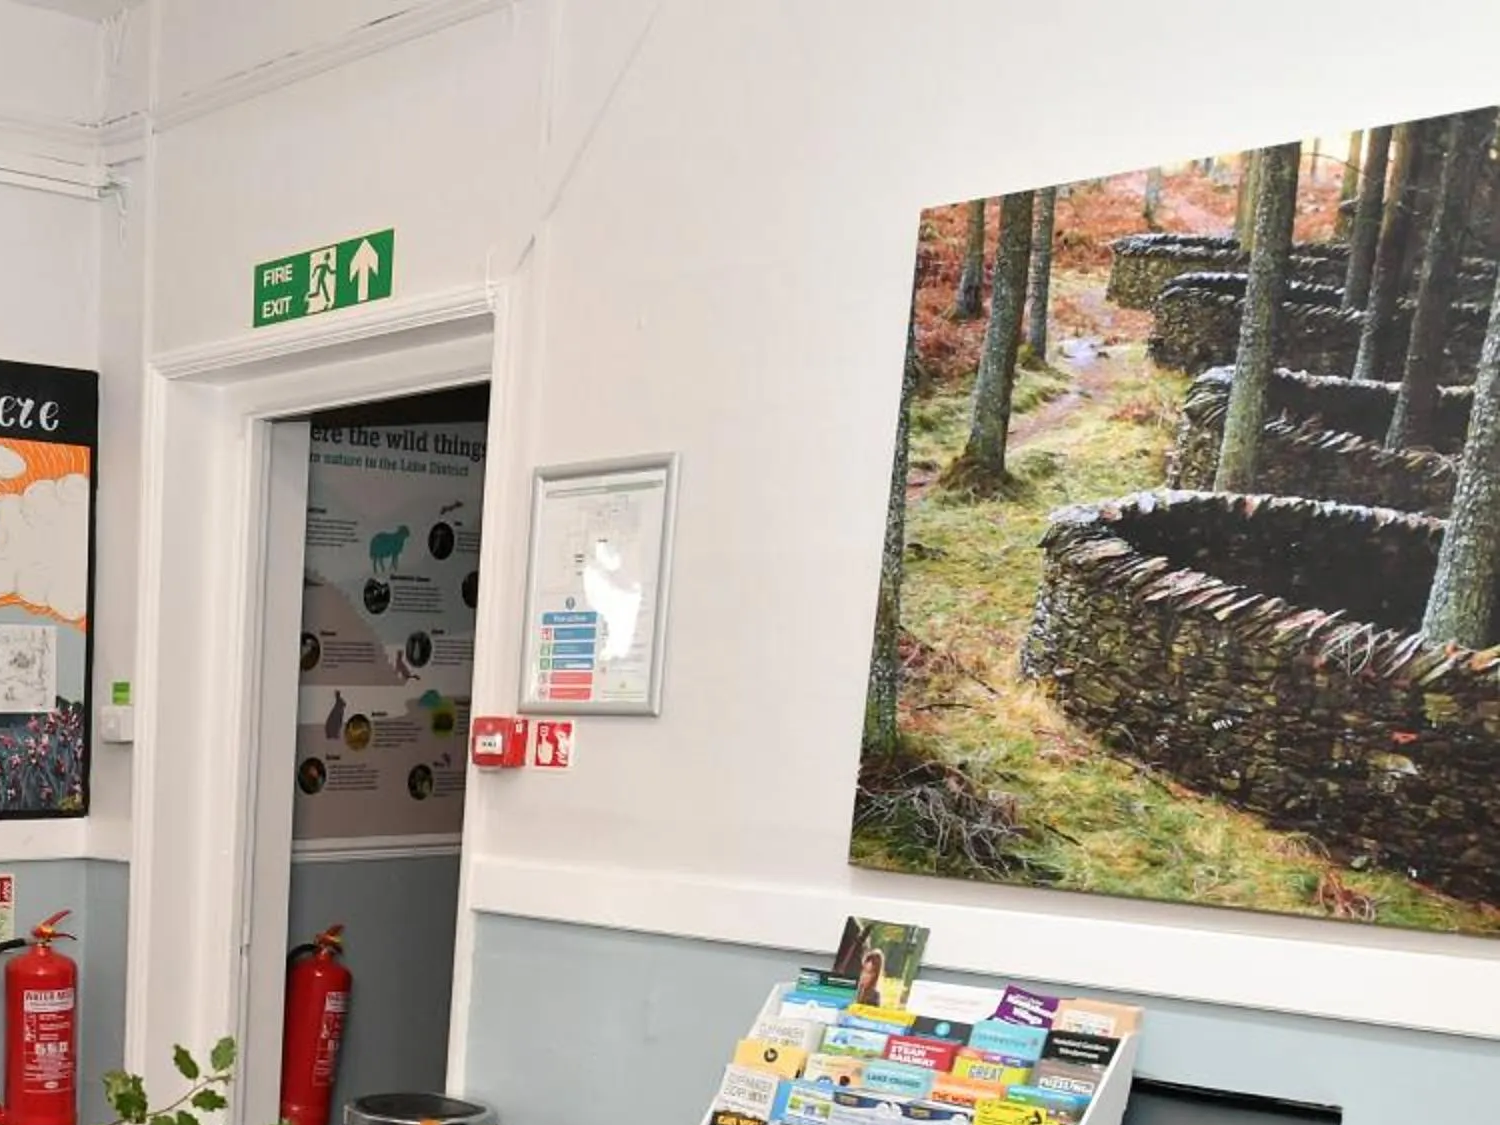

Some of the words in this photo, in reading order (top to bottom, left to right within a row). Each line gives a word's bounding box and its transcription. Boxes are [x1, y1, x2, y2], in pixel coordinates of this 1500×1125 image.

[263, 264, 293, 288] FIRE
[261, 296, 293, 319] EXIT
[311, 425, 343, 444] ere
[349, 425, 381, 448] the
[387, 429, 429, 452] wild
